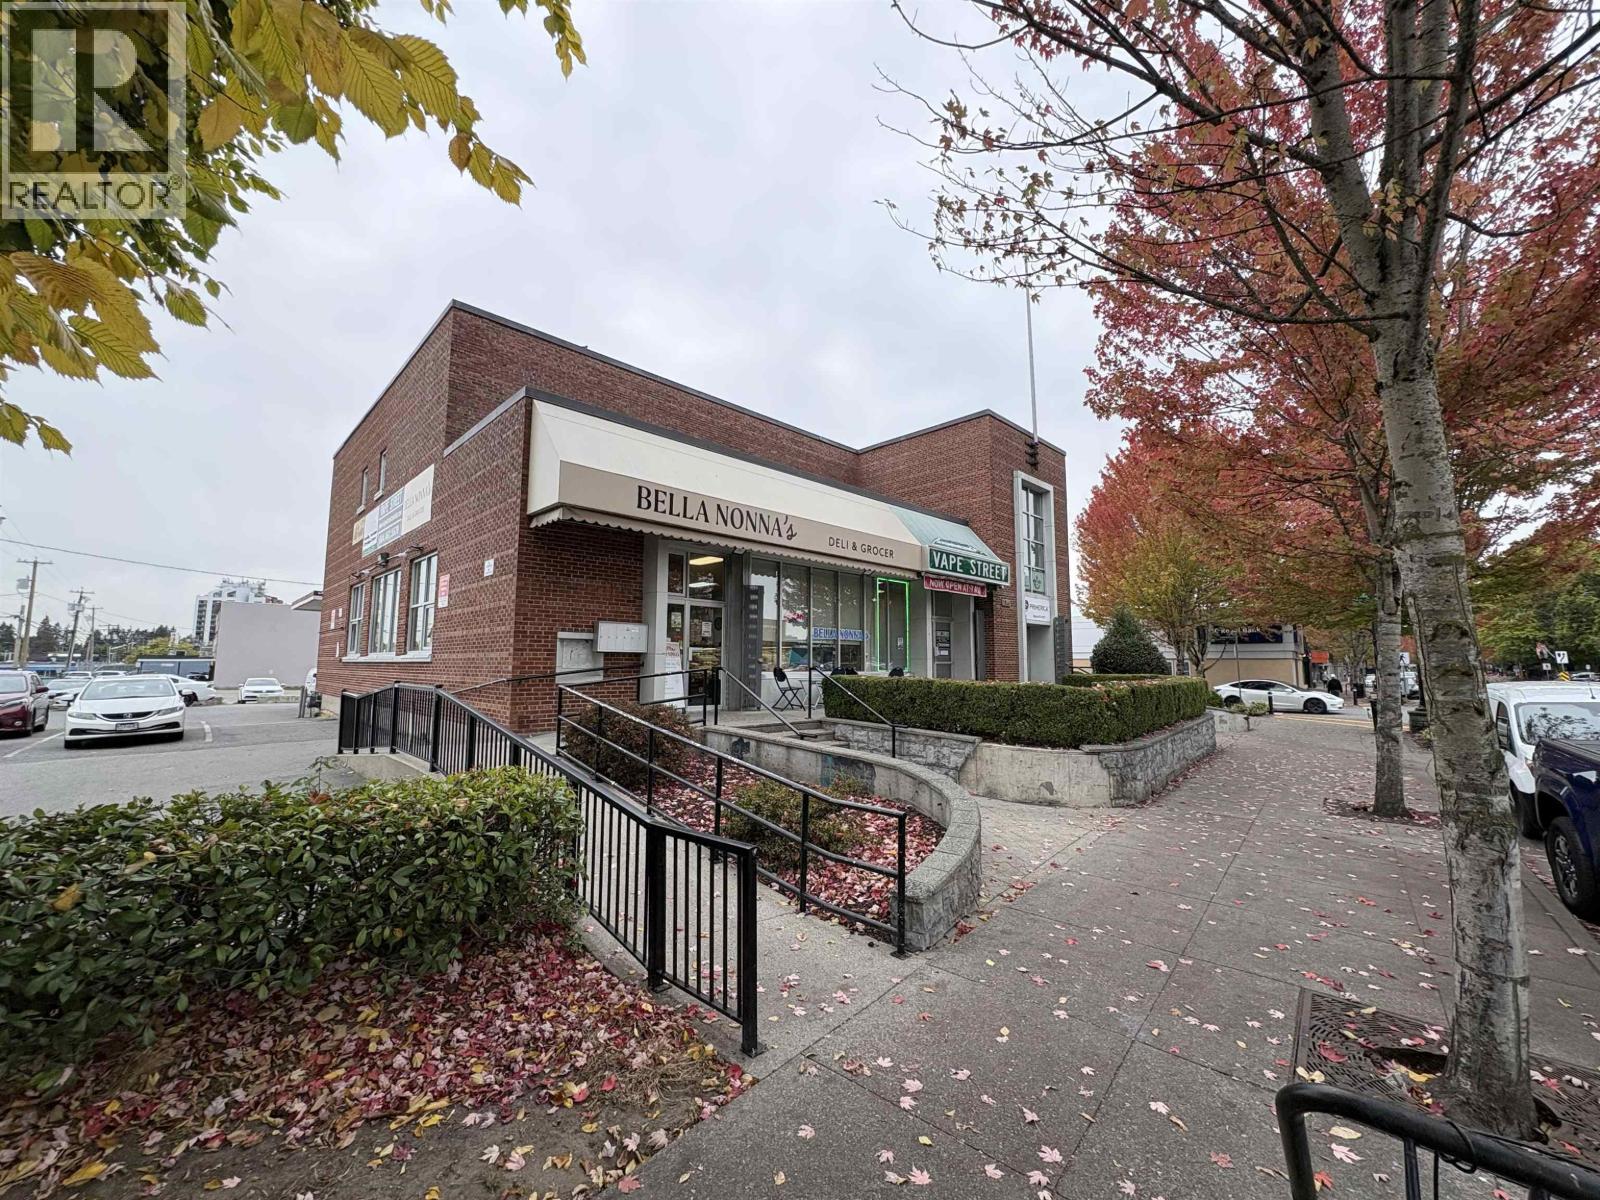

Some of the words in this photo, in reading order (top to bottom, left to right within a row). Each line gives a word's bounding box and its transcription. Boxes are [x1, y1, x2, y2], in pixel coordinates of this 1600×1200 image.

[636, 485, 710, 524] BELLA
[828, 536, 849, 549] DELI
[852, 541, 858, 551] &
[860, 543, 894, 559] GROCER
[932, 550, 964, 572] VAPE
[969, 560, 1007, 581] STREET
[929, 578, 944, 589] NOW
[945, 580, 962, 592] OPEN
